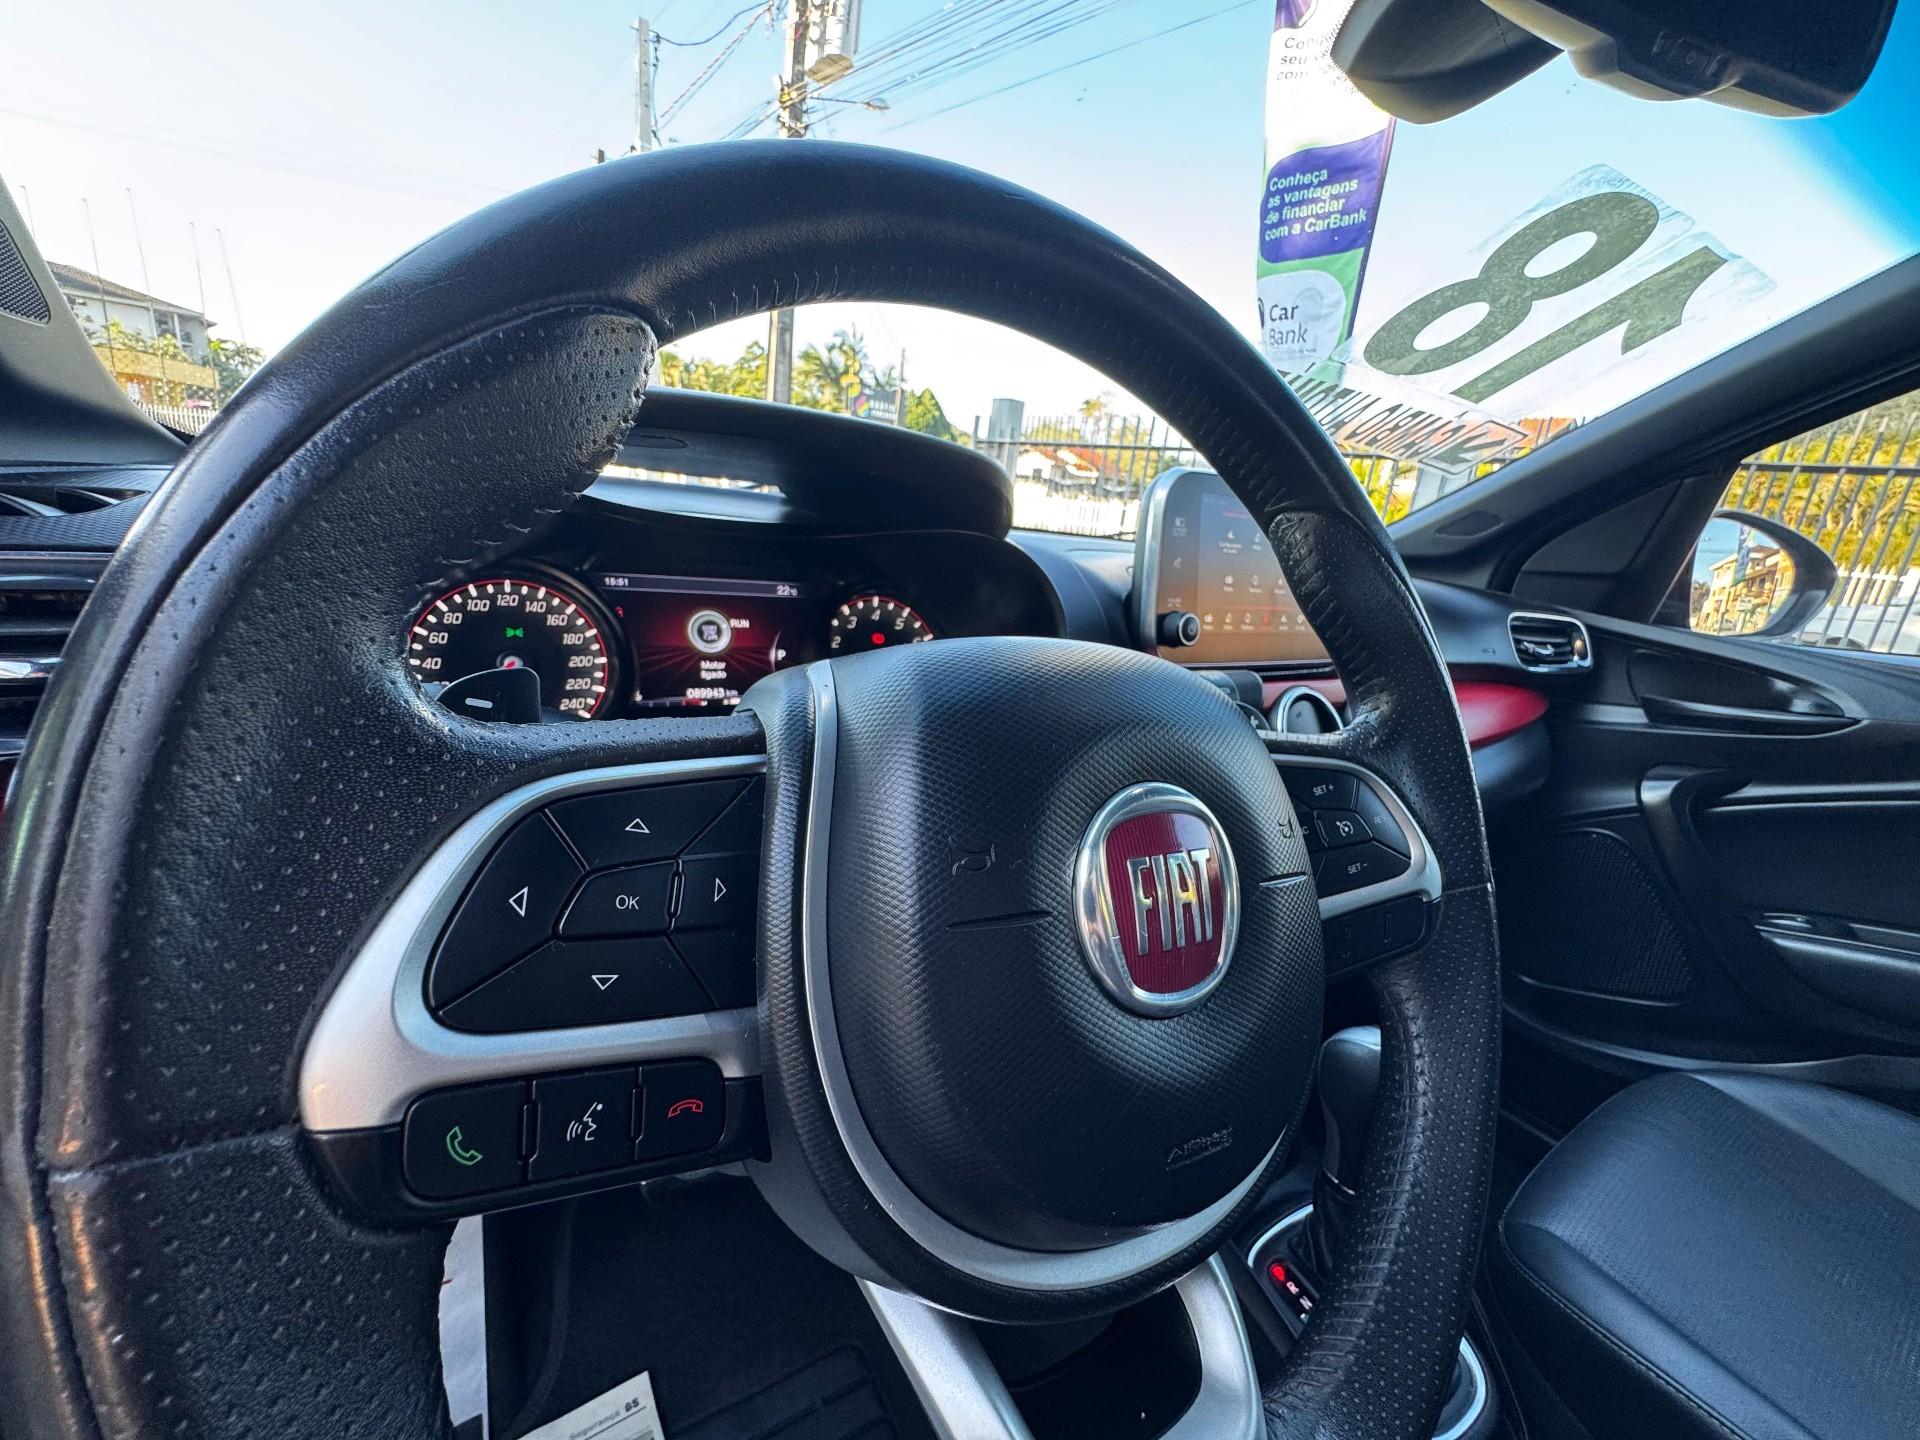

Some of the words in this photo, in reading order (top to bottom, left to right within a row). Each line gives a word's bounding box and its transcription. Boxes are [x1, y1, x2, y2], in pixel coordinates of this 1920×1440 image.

[1269, 168, 1328, 191] Conheça
[1267, 197, 1280, 209] as
[1284, 179, 1358, 205] vantagens
[1265, 211, 1279, 225] de
[1282, 198, 1345, 221] financiar
[1264, 226, 1288, 241] com
[1291, 223, 1301, 235] a
[1304, 208, 1367, 233] CarBank
[1269, 303, 1299, 322] Car
[1269, 322, 1308, 346] Bank
[467, 599, 490, 612] 100
[497, 594, 519, 606] 120
[525, 600, 546, 613] 140
[443, 612, 463, 625] 80
[546, 614, 568, 626] 160
[846, 615, 858, 629] 3
[870, 609, 881, 622] 4
[730, 618, 750, 629] RUN
[894, 617, 905, 630] 5
[428, 632, 448, 644] 60
[562, 633, 584, 645] 180
[830, 635, 842, 649] 2
[422, 657, 442, 670] 40
[568, 655, 594, 668] 200
[700, 660, 727, 670] Motor
[700, 669, 727, 681] ligado
[565, 677, 591, 691] 220
[559, 698, 585, 711] 240
[1313, 785, 1327, 797] SET
[1347, 861, 1362, 874] SET
[615, 895, 641, 910] OK
[1127, 847, 1214, 956] FIAT
[1286, 1281, 1300, 1295] R
[1299, 1295, 1314, 1311] N
